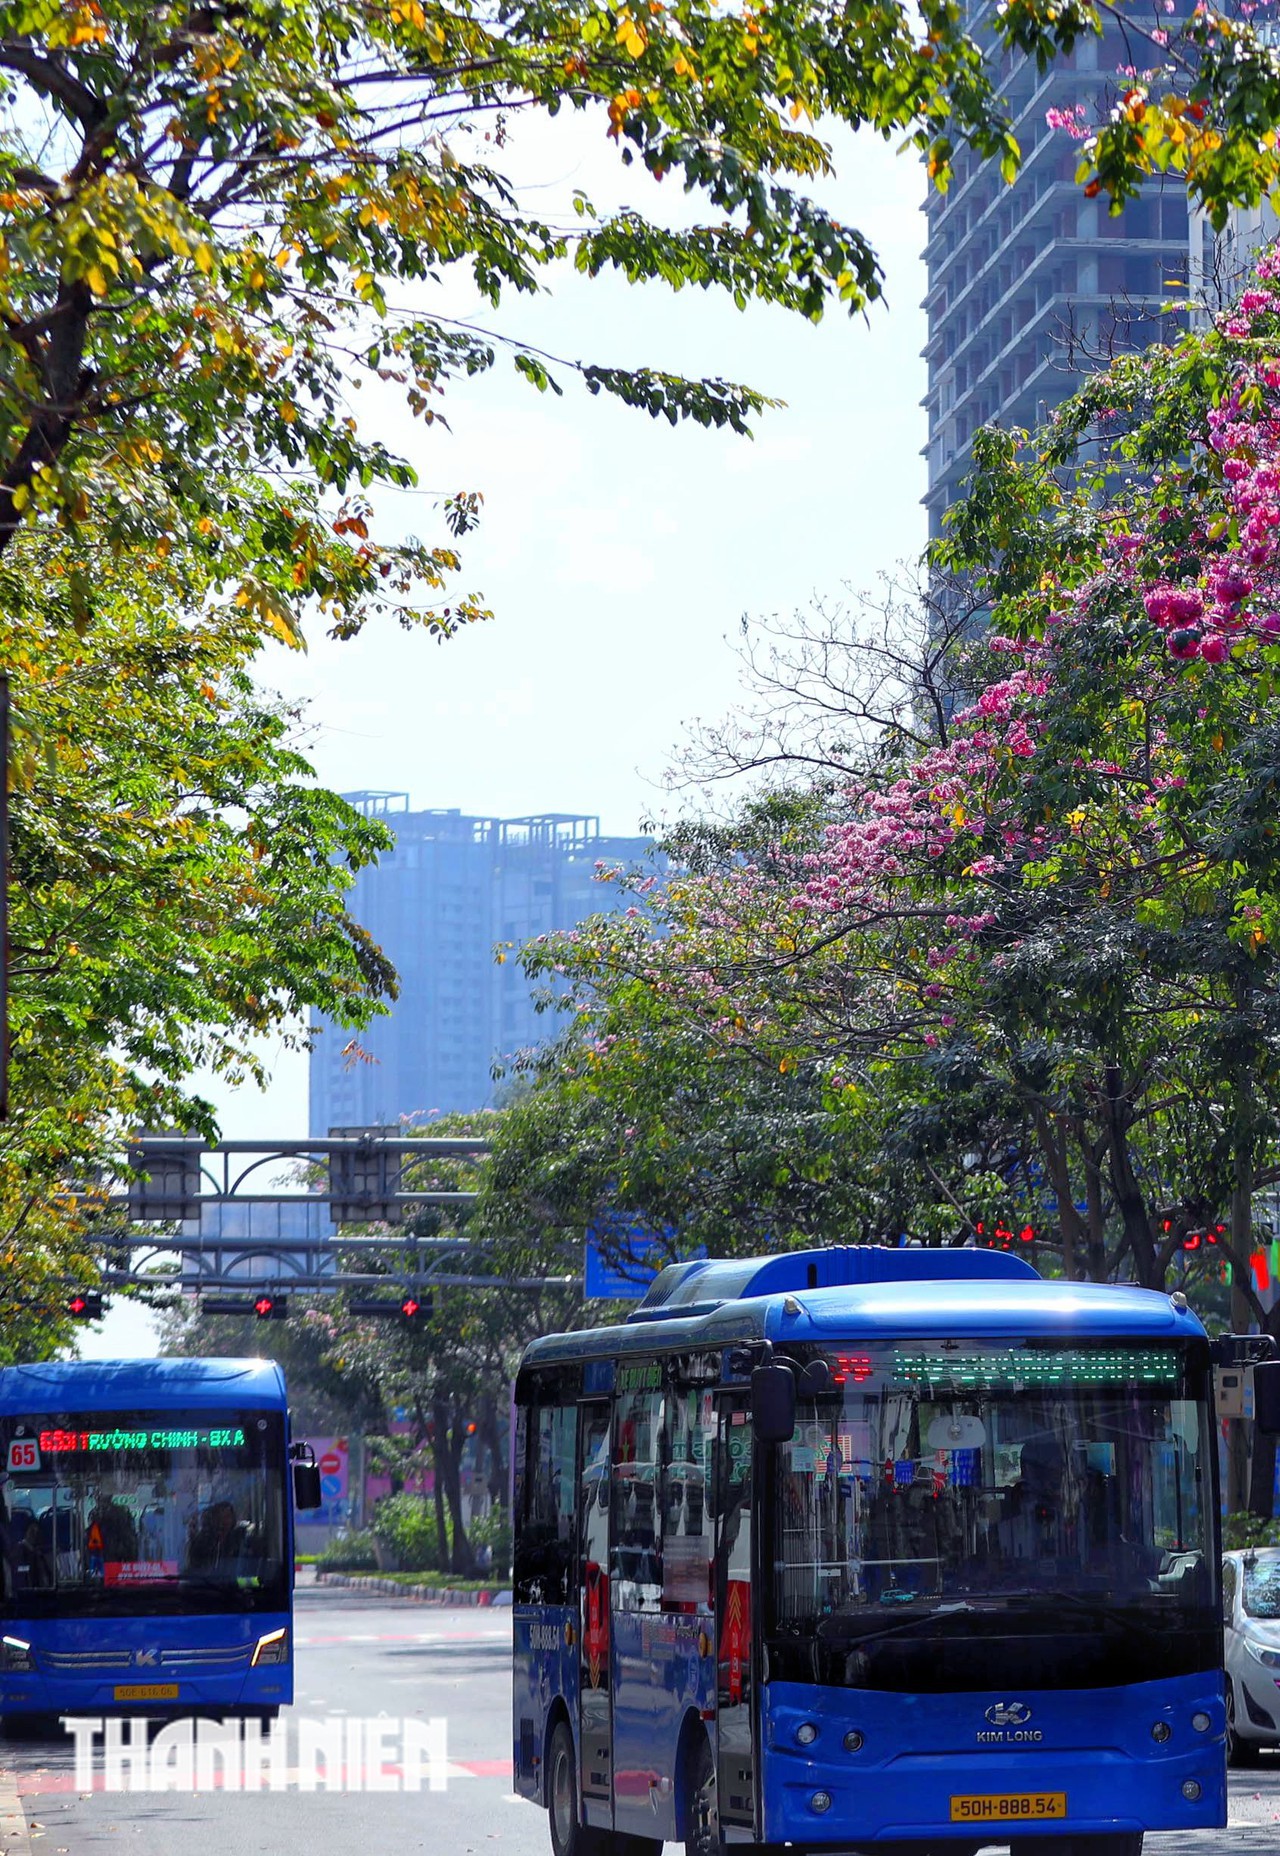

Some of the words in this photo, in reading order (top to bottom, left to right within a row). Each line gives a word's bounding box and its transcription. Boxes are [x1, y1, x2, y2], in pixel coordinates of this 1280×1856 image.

[11, 1444, 35, 1467] 65
[976, 1731, 1003, 1742] KIM
[1006, 1730, 1043, 1742] LONG
[960, 1798, 1056, 1817] 50H-888.54
